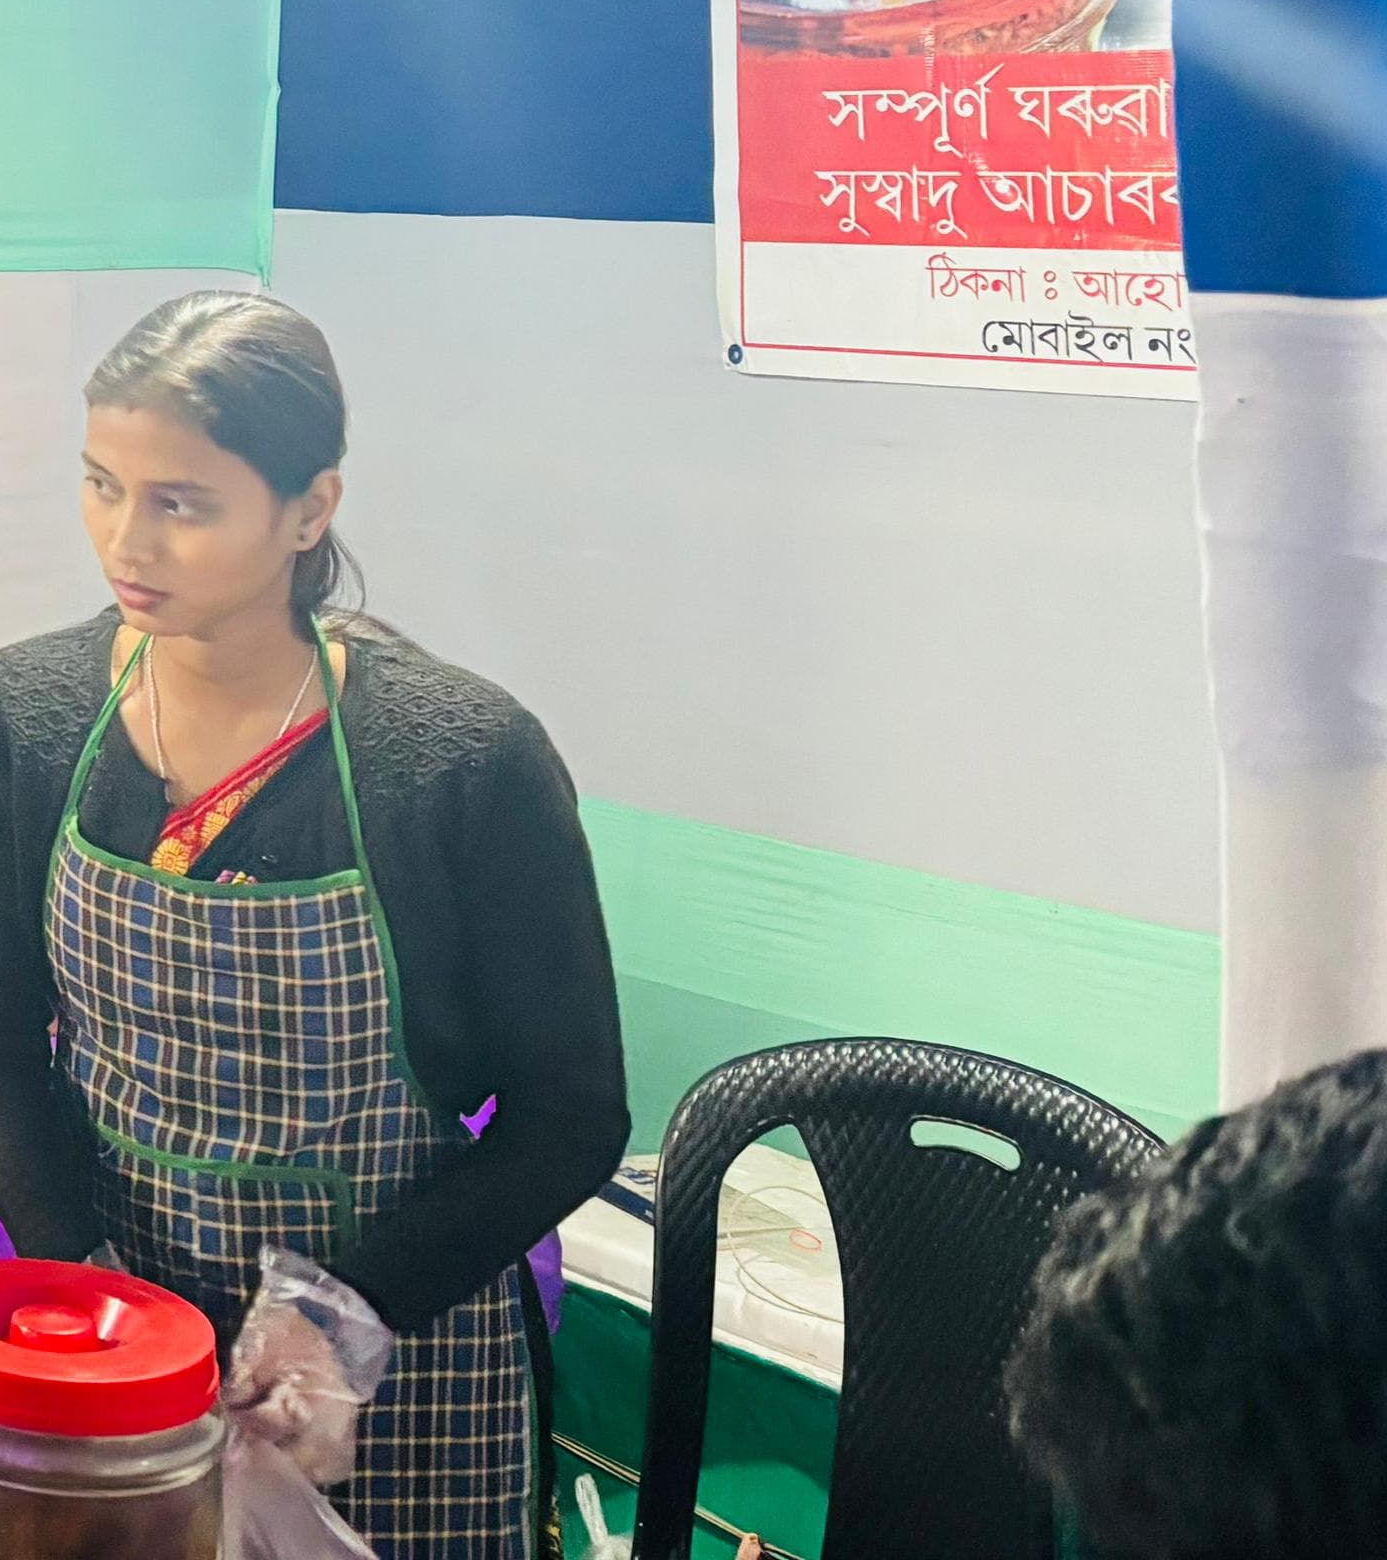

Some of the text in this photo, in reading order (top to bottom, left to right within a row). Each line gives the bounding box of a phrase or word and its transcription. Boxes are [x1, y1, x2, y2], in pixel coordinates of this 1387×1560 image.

[926, 251, 1028, 303] ঠিকনা
[1072, 268, 1189, 312] আহো
[983, 310, 1134, 362] মোবাইল
